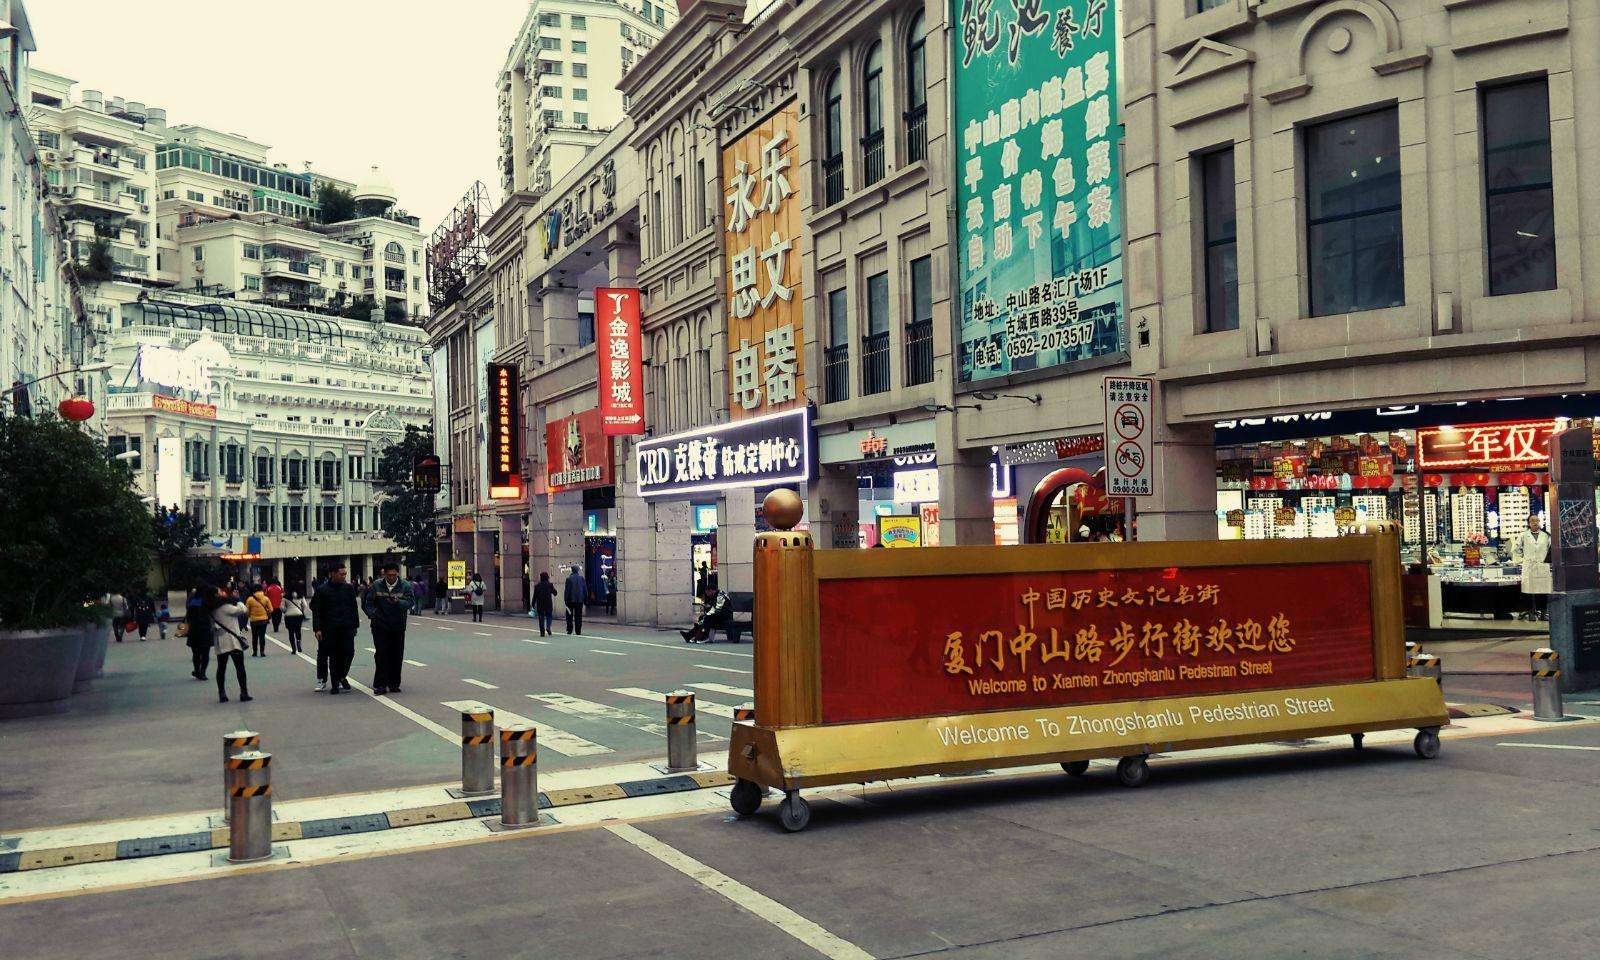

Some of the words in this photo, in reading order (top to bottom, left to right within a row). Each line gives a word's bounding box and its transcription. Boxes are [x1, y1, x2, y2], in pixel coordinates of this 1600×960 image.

[727, 129, 792, 233] 永乐
[731, 231, 794, 318] 思文
[1006, 267, 1108, 312] 中山路名汇广场1F
[1005, 301, 1079, 336] 古城西路39号
[1006, 324, 1095, 358] 0592-2073517
[608, 316, 632, 403] 金逸影城
[733, 322, 797, 410] 电器
[1109, 392, 1149, 402] 请注意安全
[638, 447, 670, 486] CRD
[1112, 486, 1149, 494] 09:00-24:00
[1021, 584, 1221, 630] 中国历史文化名街
[943, 612, 1297, 675] 厦门中山路步行街欢迎您
[969, 678, 1028, 696] Welcome
[1032, 675, 1047, 692] to
[1052, 672, 1098, 690] Xiamen
[1102, 666, 1175, 687] Zhongshanlu
[1179, 664, 1237, 681] Pedestrian
[1240, 660, 1273, 676] Street
[936, 724, 1030, 747] Welcome
[1035, 717, 1061, 738] To
[1066, 708, 1184, 737] Zhongshanlu
[1188, 700, 1280, 725] Pedestrian
[1284, 696, 1336, 716] Street
